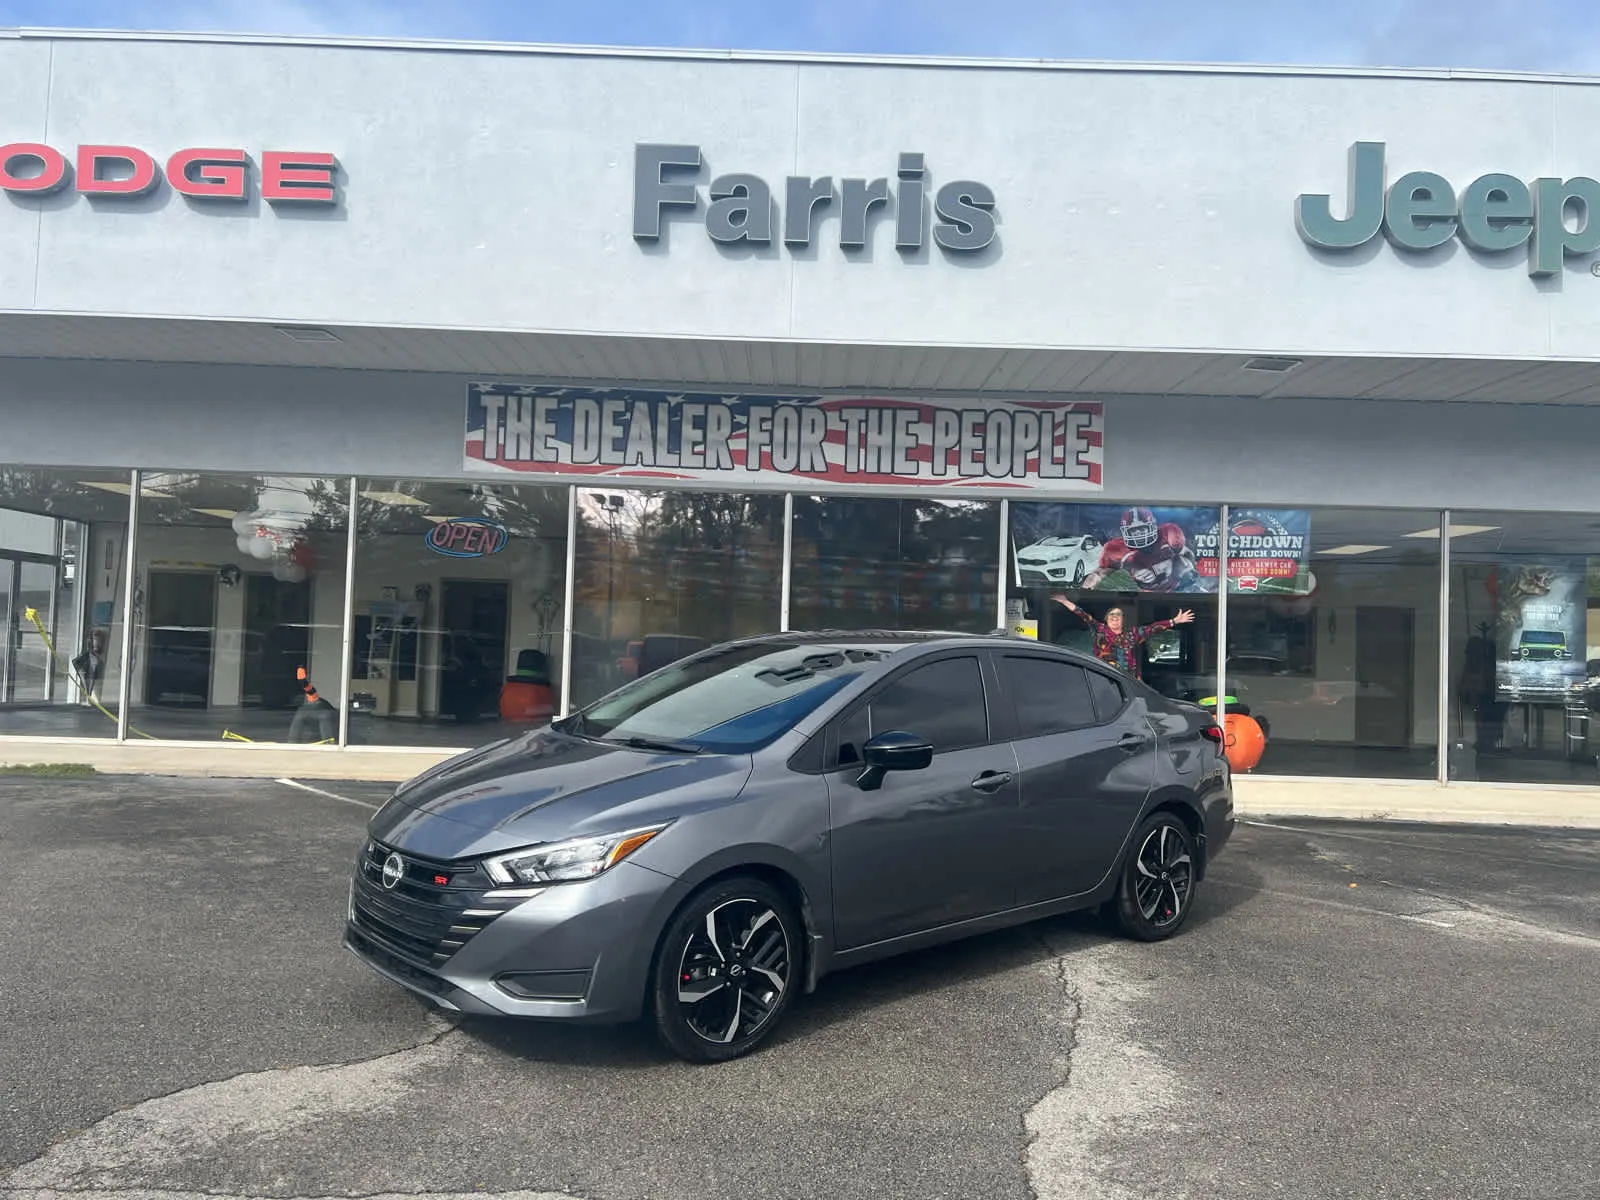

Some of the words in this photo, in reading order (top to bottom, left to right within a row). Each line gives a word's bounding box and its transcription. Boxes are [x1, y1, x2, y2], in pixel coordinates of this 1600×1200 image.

[633, 142, 996, 252] Farris
[1294, 141, 1600, 277] Jeep
[480, 394, 559, 462] THE
[570, 398, 735, 470] DEALER
[746, 404, 829, 473] FOR
[839, 407, 921, 476] THE
[931, 409, 1092, 479] PEOPLE
[432, 520, 499, 553] OPEN
[1196, 548, 1215, 557] FOR
[1217, 549, 1237, 558] OT
[1239, 549, 1268, 558] MUCH
[1270, 549, 1302, 558] DOWN!
[434, 876, 448, 885] SR
